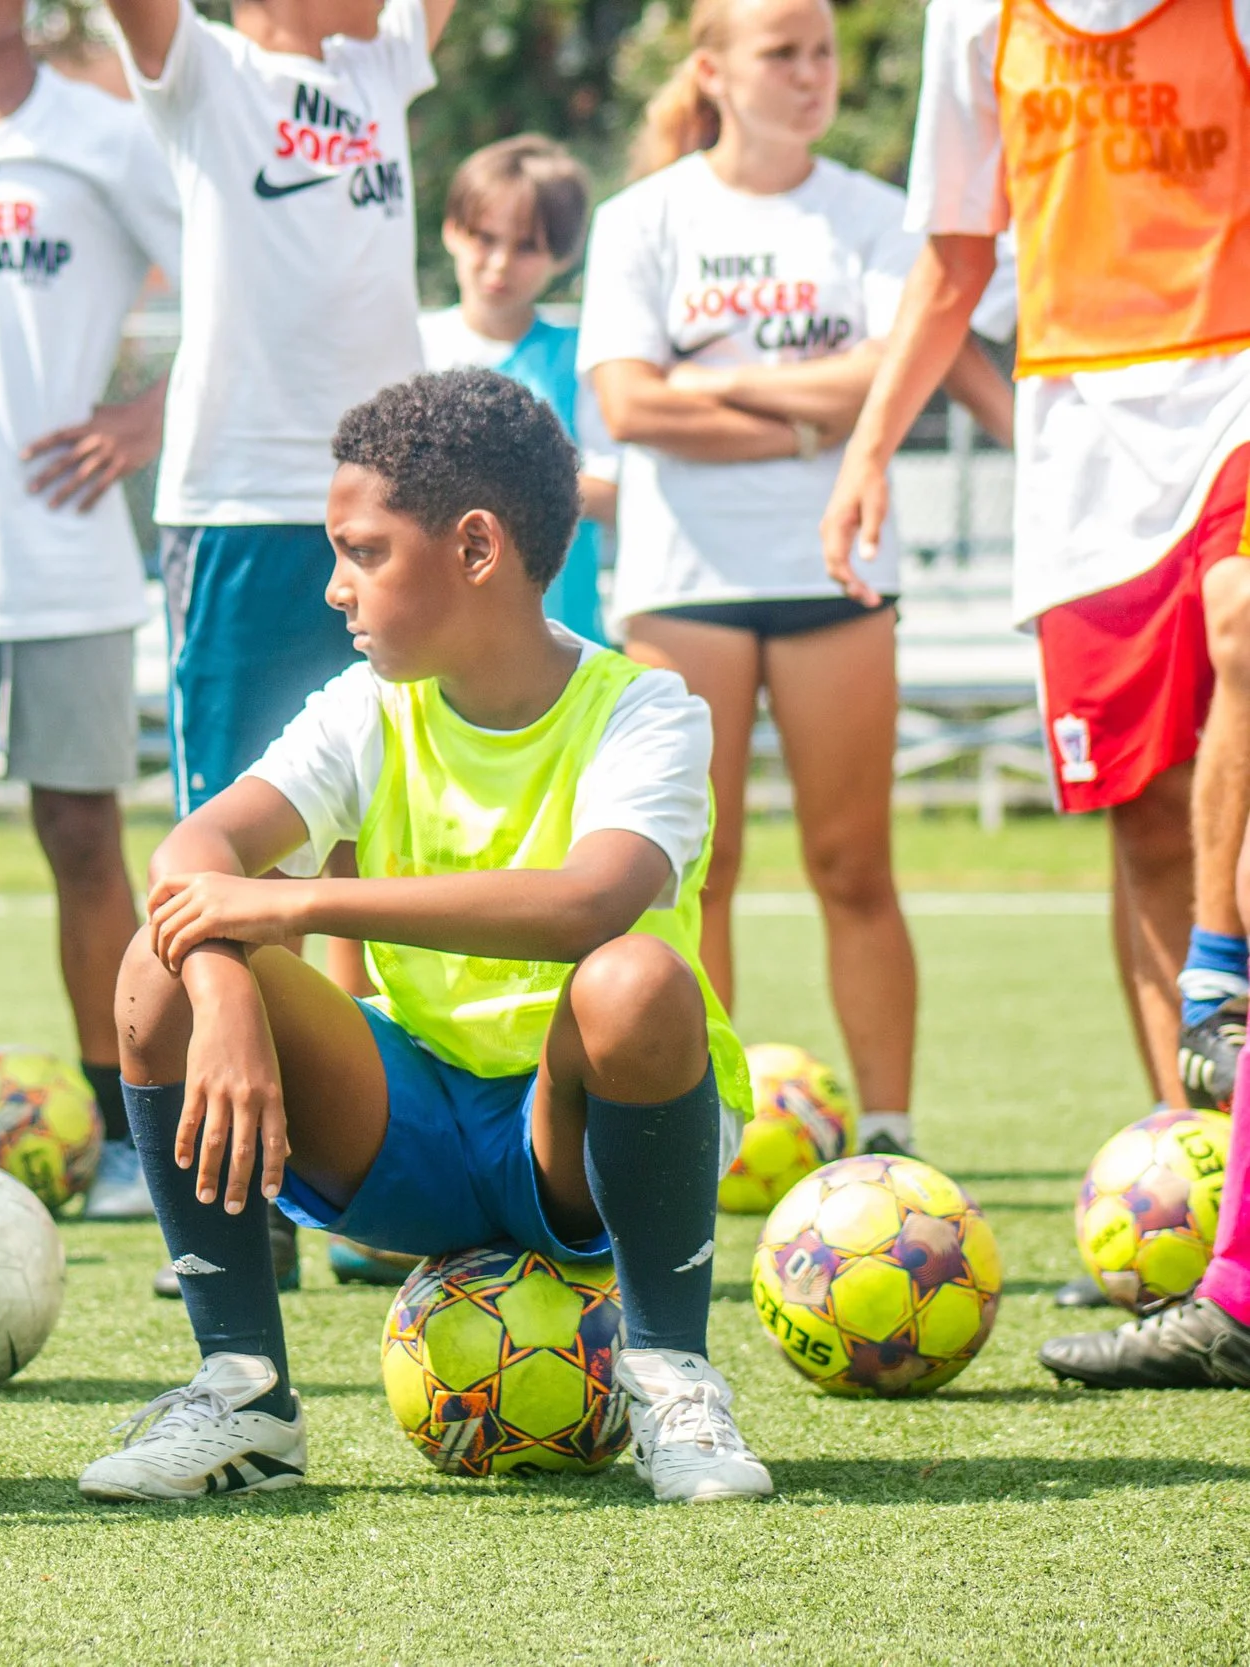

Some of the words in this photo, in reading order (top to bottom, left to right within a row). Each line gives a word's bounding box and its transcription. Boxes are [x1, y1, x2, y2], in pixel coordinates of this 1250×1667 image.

[1043, 38, 1136, 84] NIKE
[1022, 82, 1180, 135] SOCCER
[1102, 125, 1228, 175] CAMP
[700, 253, 776, 279] NIKE
[685, 279, 818, 324] SOCCER
[754, 315, 854, 350] CAMP
